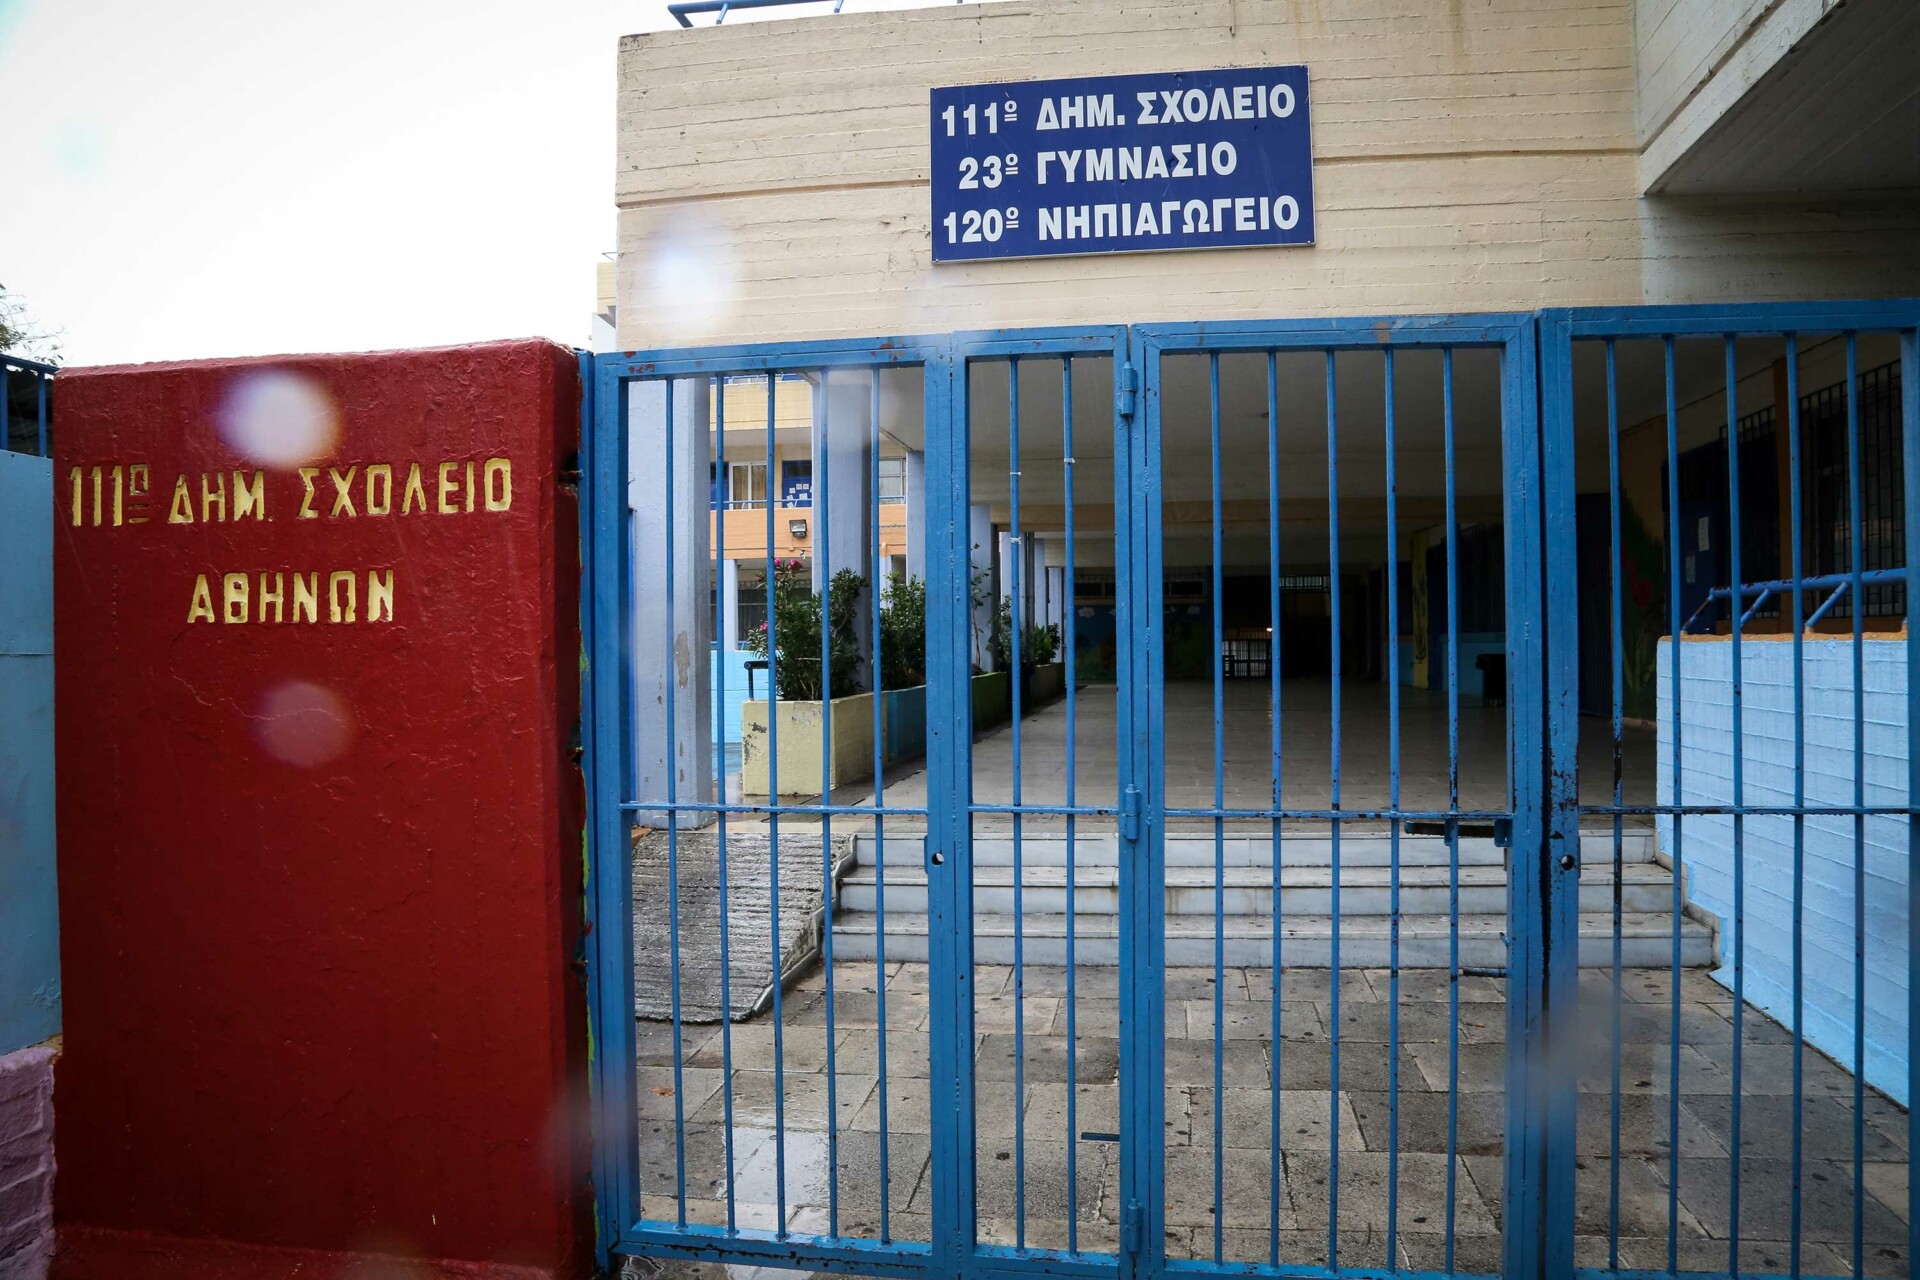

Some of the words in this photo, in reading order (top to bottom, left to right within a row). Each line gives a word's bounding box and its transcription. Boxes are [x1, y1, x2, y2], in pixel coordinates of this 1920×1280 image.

[1036, 94, 1126, 131] ΔΗΜ.
[1137, 83, 1296, 124] ΣΧΟΛΕΙΟ
[1037, 141, 1237, 185] ΓΥΜΝΑΣΙΟ
[1038, 194, 1300, 241] ΝΗΠΙΑΓΩΓΕΙΟ
[168, 470, 274, 524] ΔΗΜ.
[298, 457, 512, 519] ΣΧΟΛΕΙΟ
[187, 569, 394, 624] ΑΘΗΝΩΝ
